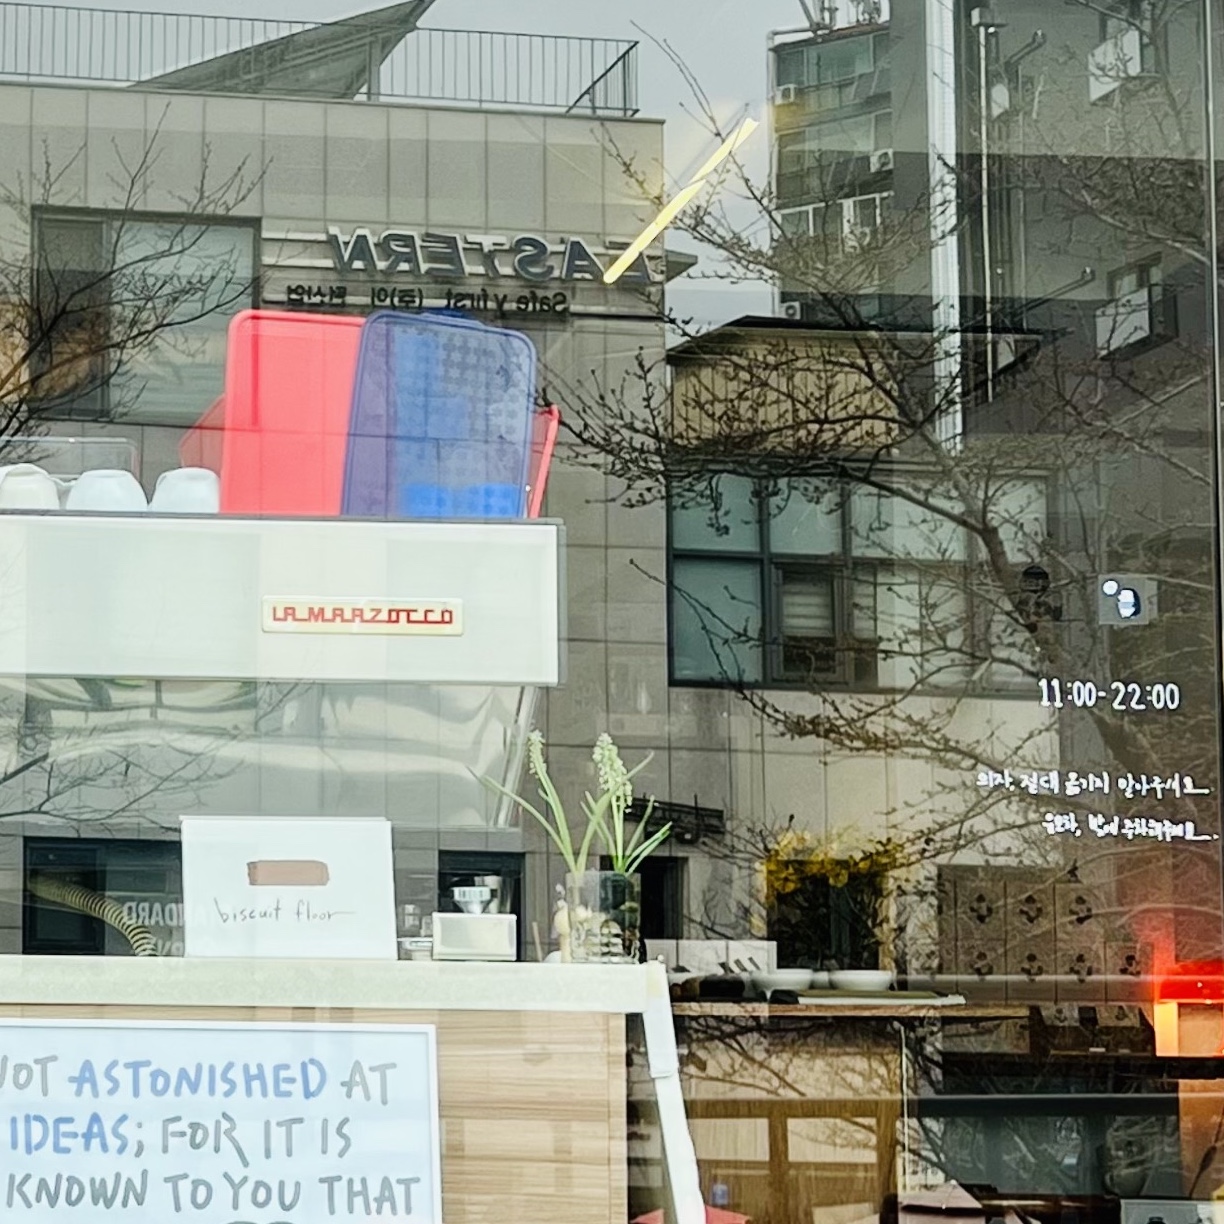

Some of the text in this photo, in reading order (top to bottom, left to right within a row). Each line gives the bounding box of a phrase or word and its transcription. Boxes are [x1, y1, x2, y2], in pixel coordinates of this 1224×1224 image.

[1038, 678, 1180, 710] 11:00-22:00
[214, 898, 356, 923] biscuit floor
[68, 1058, 327, 1099] ASTONISHED
[341, 1060, 397, 1105] AT
[10, 1112, 144, 1157] IDEAS;
[162, 1111, 249, 1168] FOR
[264, 1117, 305, 1159] IT
[321, 1117, 351, 1158] IS
[6, 1168, 148, 1209] KNOWN
[164, 1173, 213, 1213] TO
[223, 1172, 301, 1211] YOU
[319, 1175, 420, 1215] THAT
